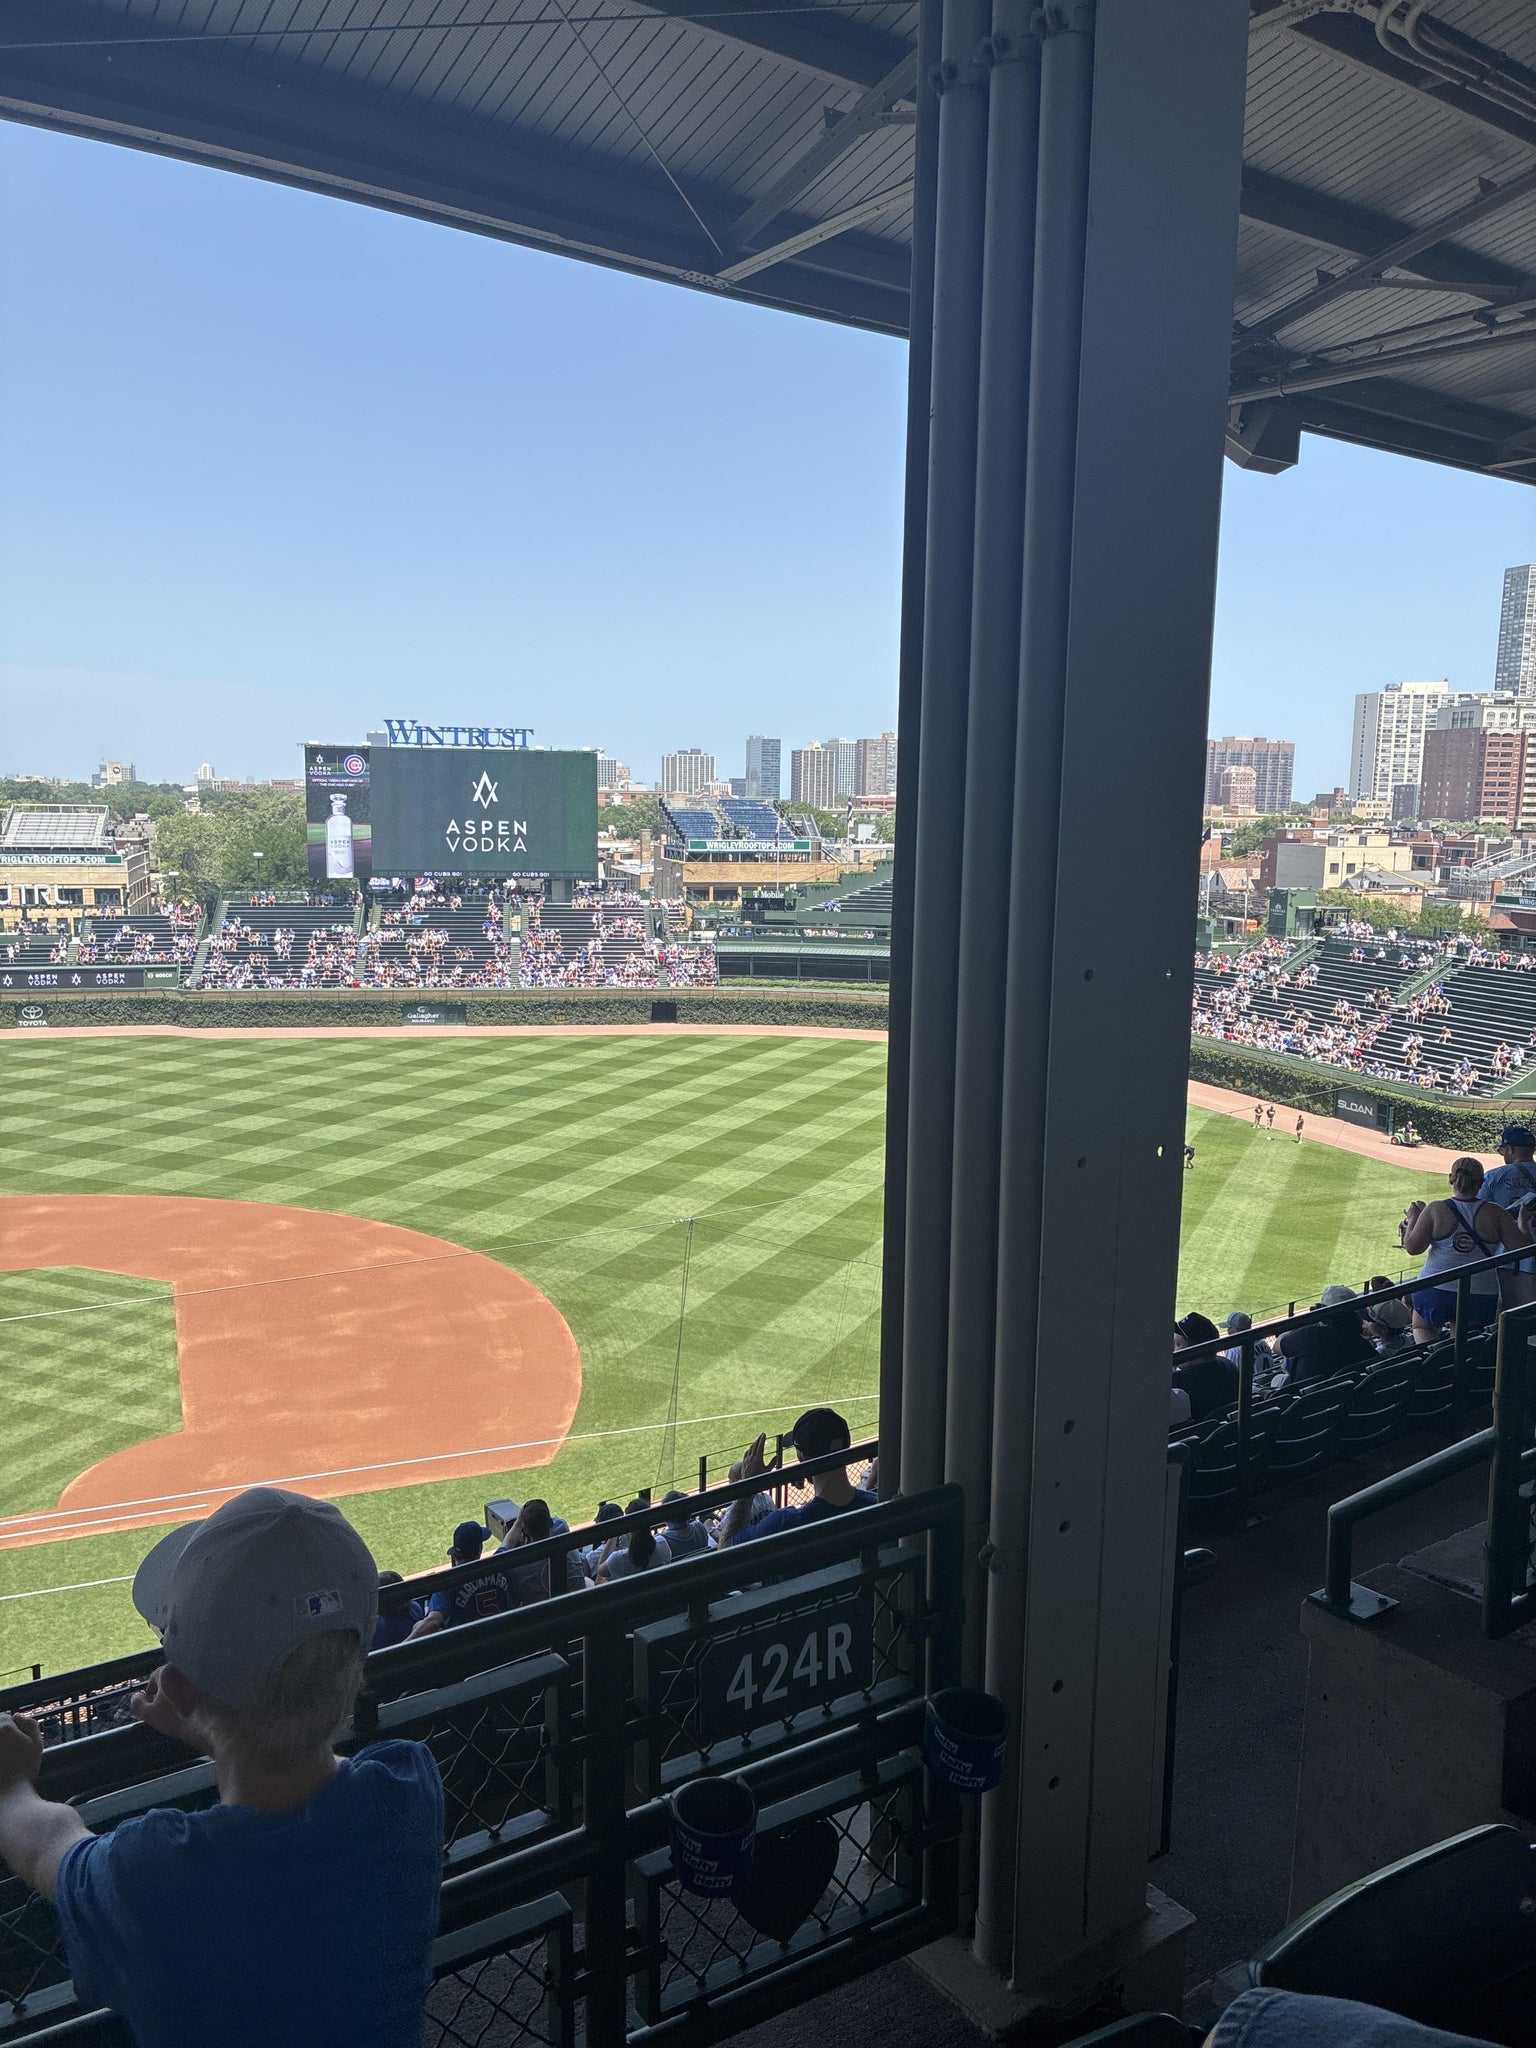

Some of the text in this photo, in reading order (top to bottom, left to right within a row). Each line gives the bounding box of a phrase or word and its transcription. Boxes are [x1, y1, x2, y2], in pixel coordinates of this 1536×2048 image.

[383, 719, 535, 748] WINTRUST
[446, 819, 527, 835] ASPEN
[446, 837, 527, 853] VODKA
[706, 841, 794, 849] WRIGLEYROOFTOPS.COM
[0, 854, 105, 864] RIGLEYROOFTOPS.COM
[760, 890, 784, 898] Mobile
[1337, 1099, 1373, 1116] SLOAN
[475, 1588, 501, 1616] 5
[726, 1623, 853, 1711] 424R
[940, 1751, 972, 1772] Hefty
[949, 1772, 986, 1787] Hefty
[683, 1852, 718, 1872] Hefty
[694, 1874, 733, 1888] Hefty
